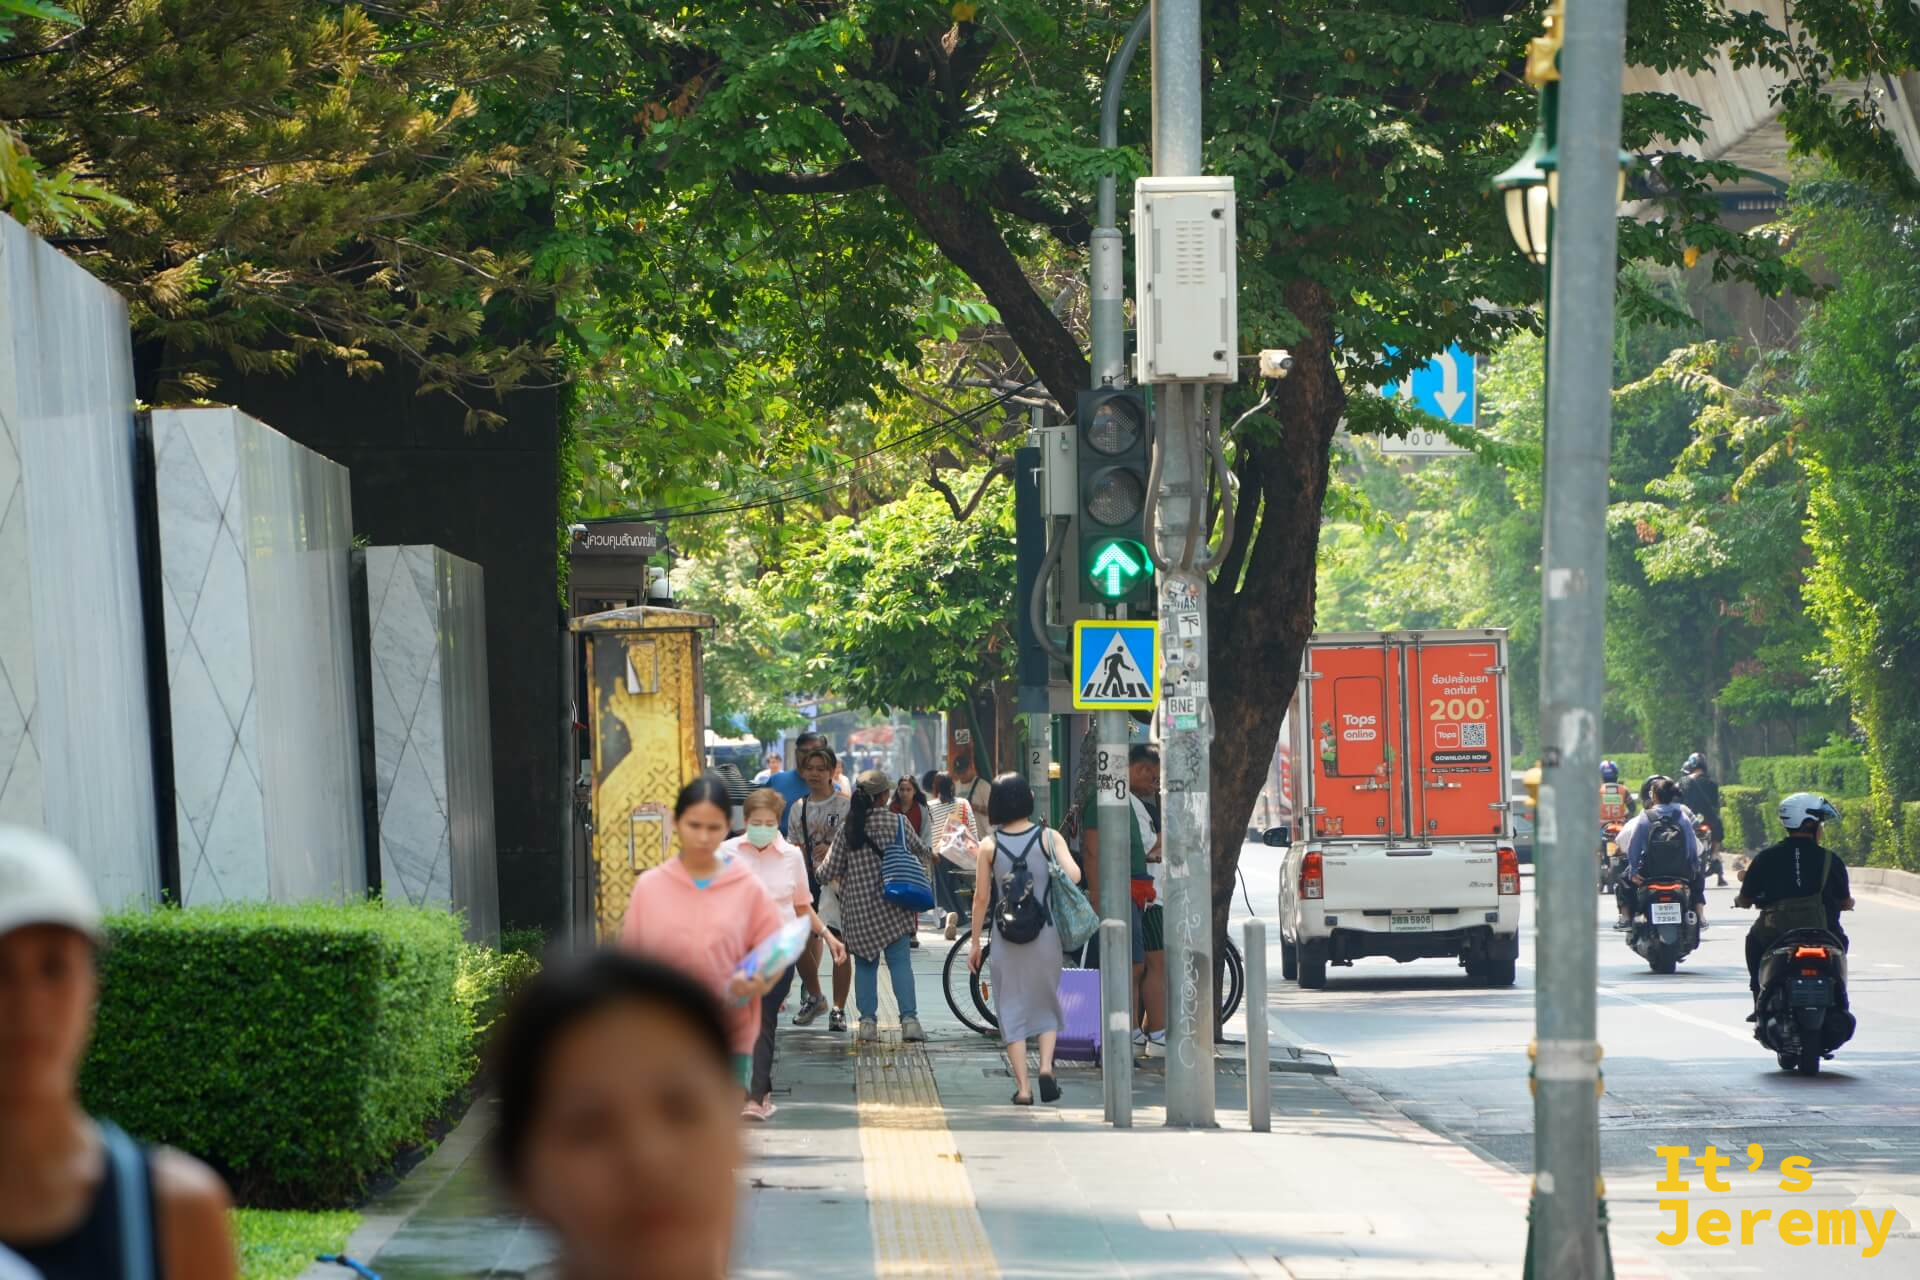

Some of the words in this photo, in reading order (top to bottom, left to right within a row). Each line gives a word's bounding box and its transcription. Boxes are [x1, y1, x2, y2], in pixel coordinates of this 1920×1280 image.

[1170, 698, 1195, 713] BNE
[1342, 714, 1376, 727] Tops
[1345, 729, 1375, 739] online
[1032, 751, 1041, 765] 2
[1098, 751, 1109, 771] 8
[1472, 753, 1488, 761] NOW
